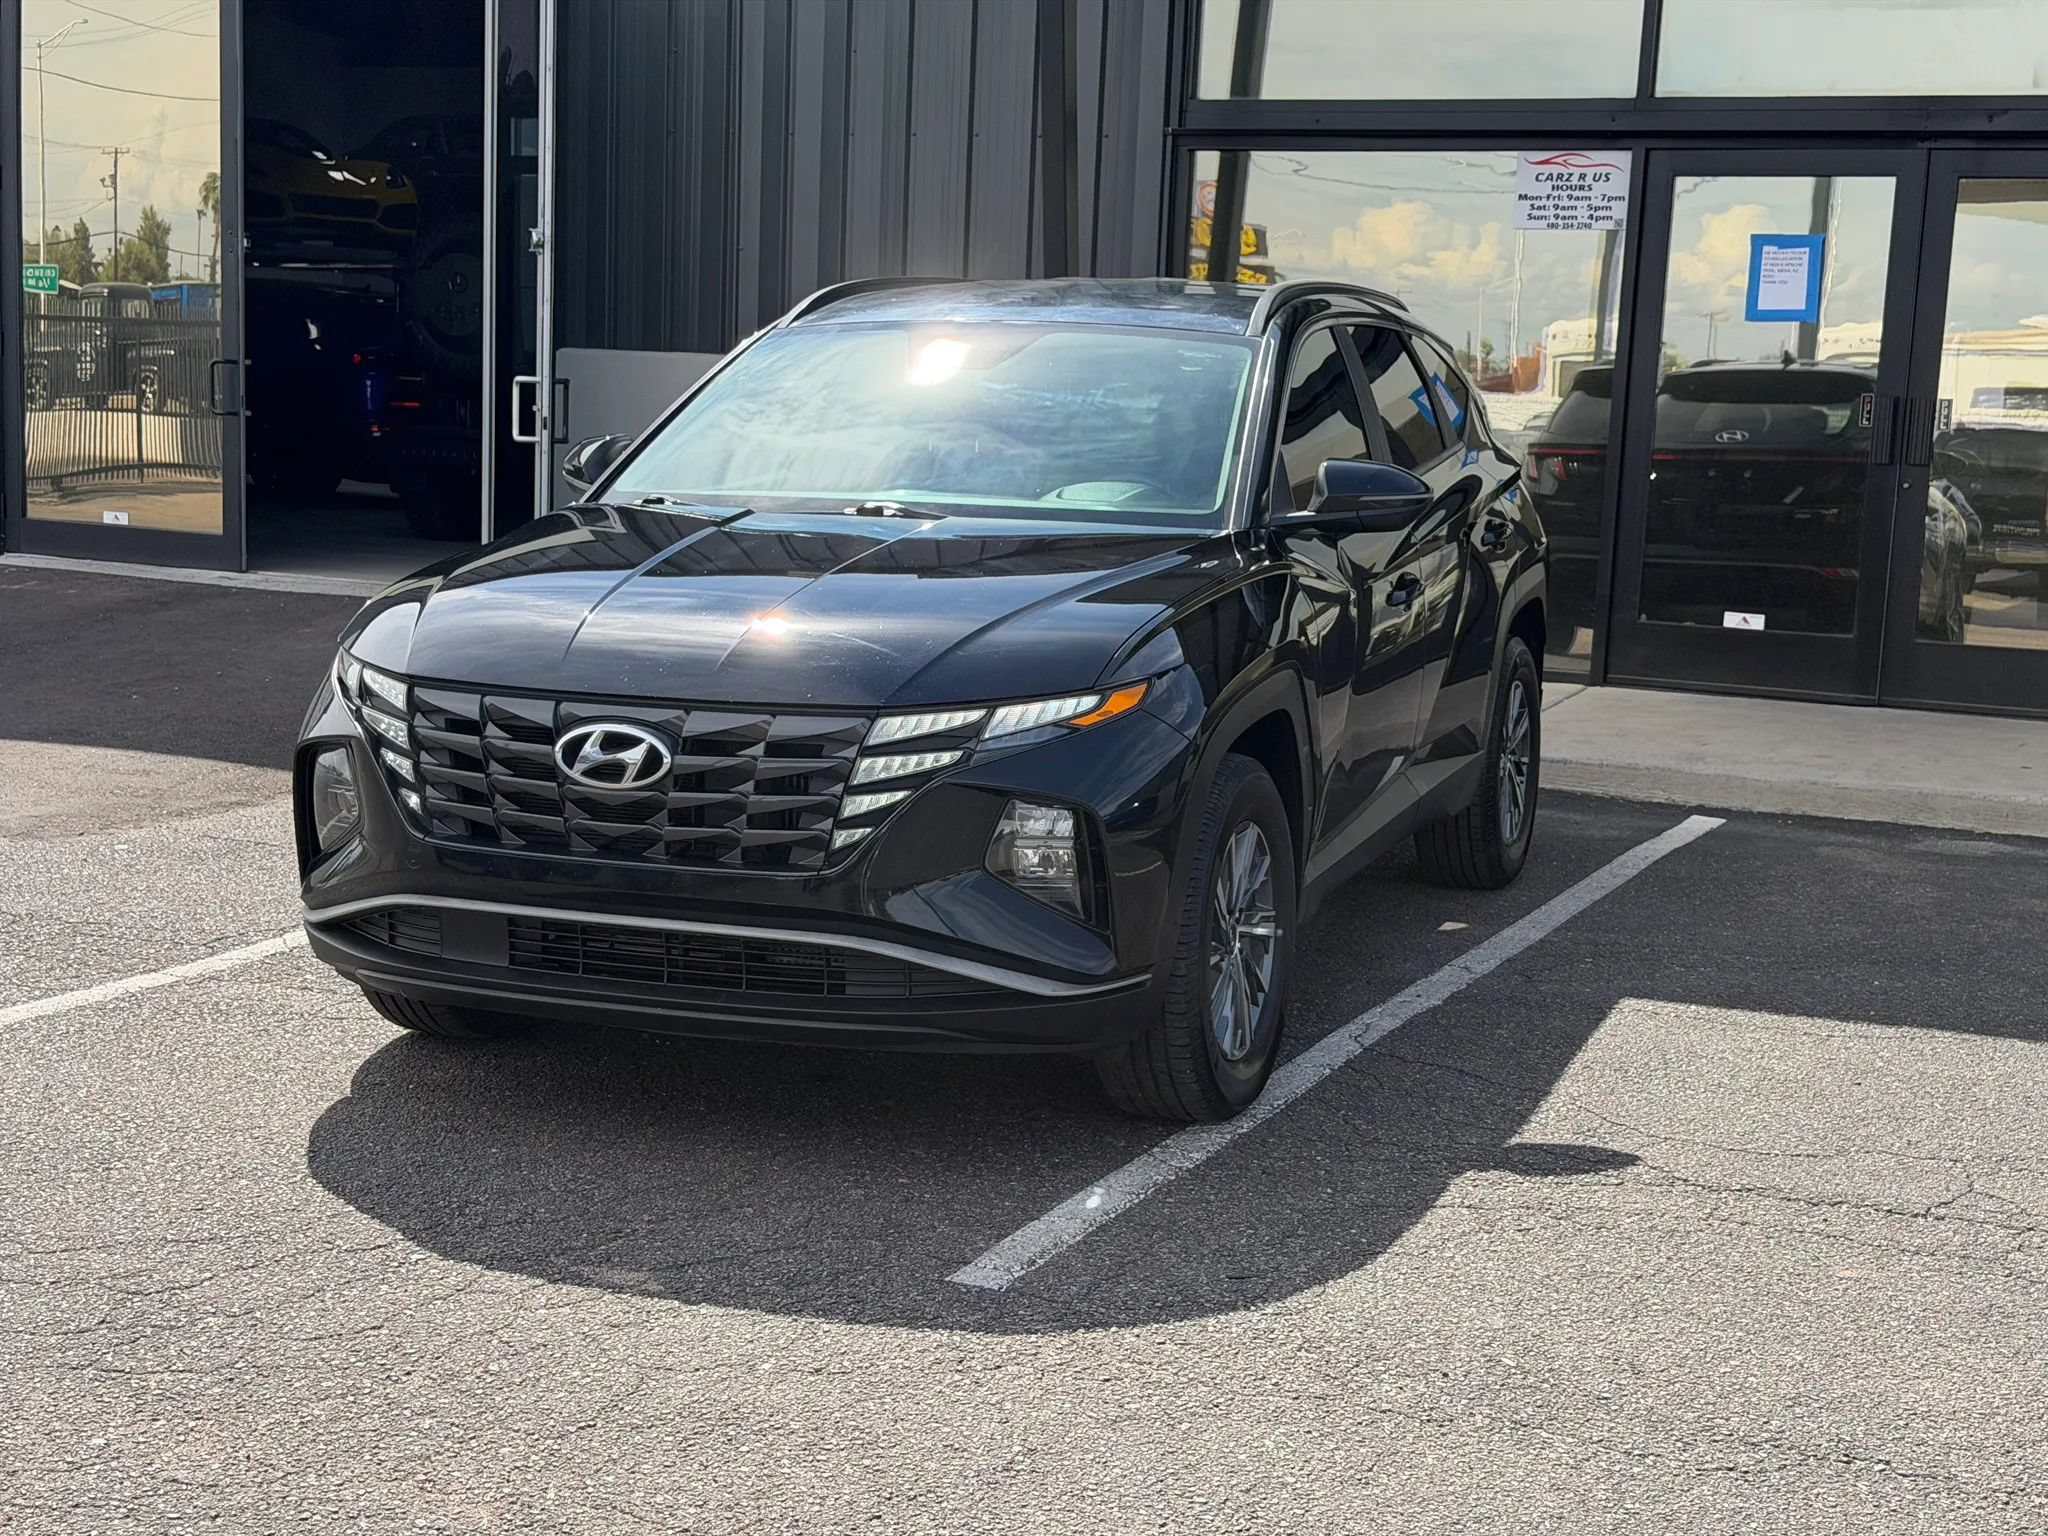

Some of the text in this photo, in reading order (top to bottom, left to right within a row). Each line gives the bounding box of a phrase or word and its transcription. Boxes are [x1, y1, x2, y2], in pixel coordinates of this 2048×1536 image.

[1535, 172, 1611, 183] CARZ R US
[1551, 184, 1593, 192] HOURS
[1518, 193, 1565, 202] Mon-Fri:
[1566, 194, 1592, 202] 9am
[1600, 194, 1626, 203] 7pm
[1529, 203, 1551, 212] Sat:
[1552, 204, 1578, 212] 9am
[1586, 204, 1612, 213] 5pm
[1526, 213, 1551, 221] Sun:
[1587, 213, 1613, 223] 4pm
[1940, 401, 1948, 429] PULL
